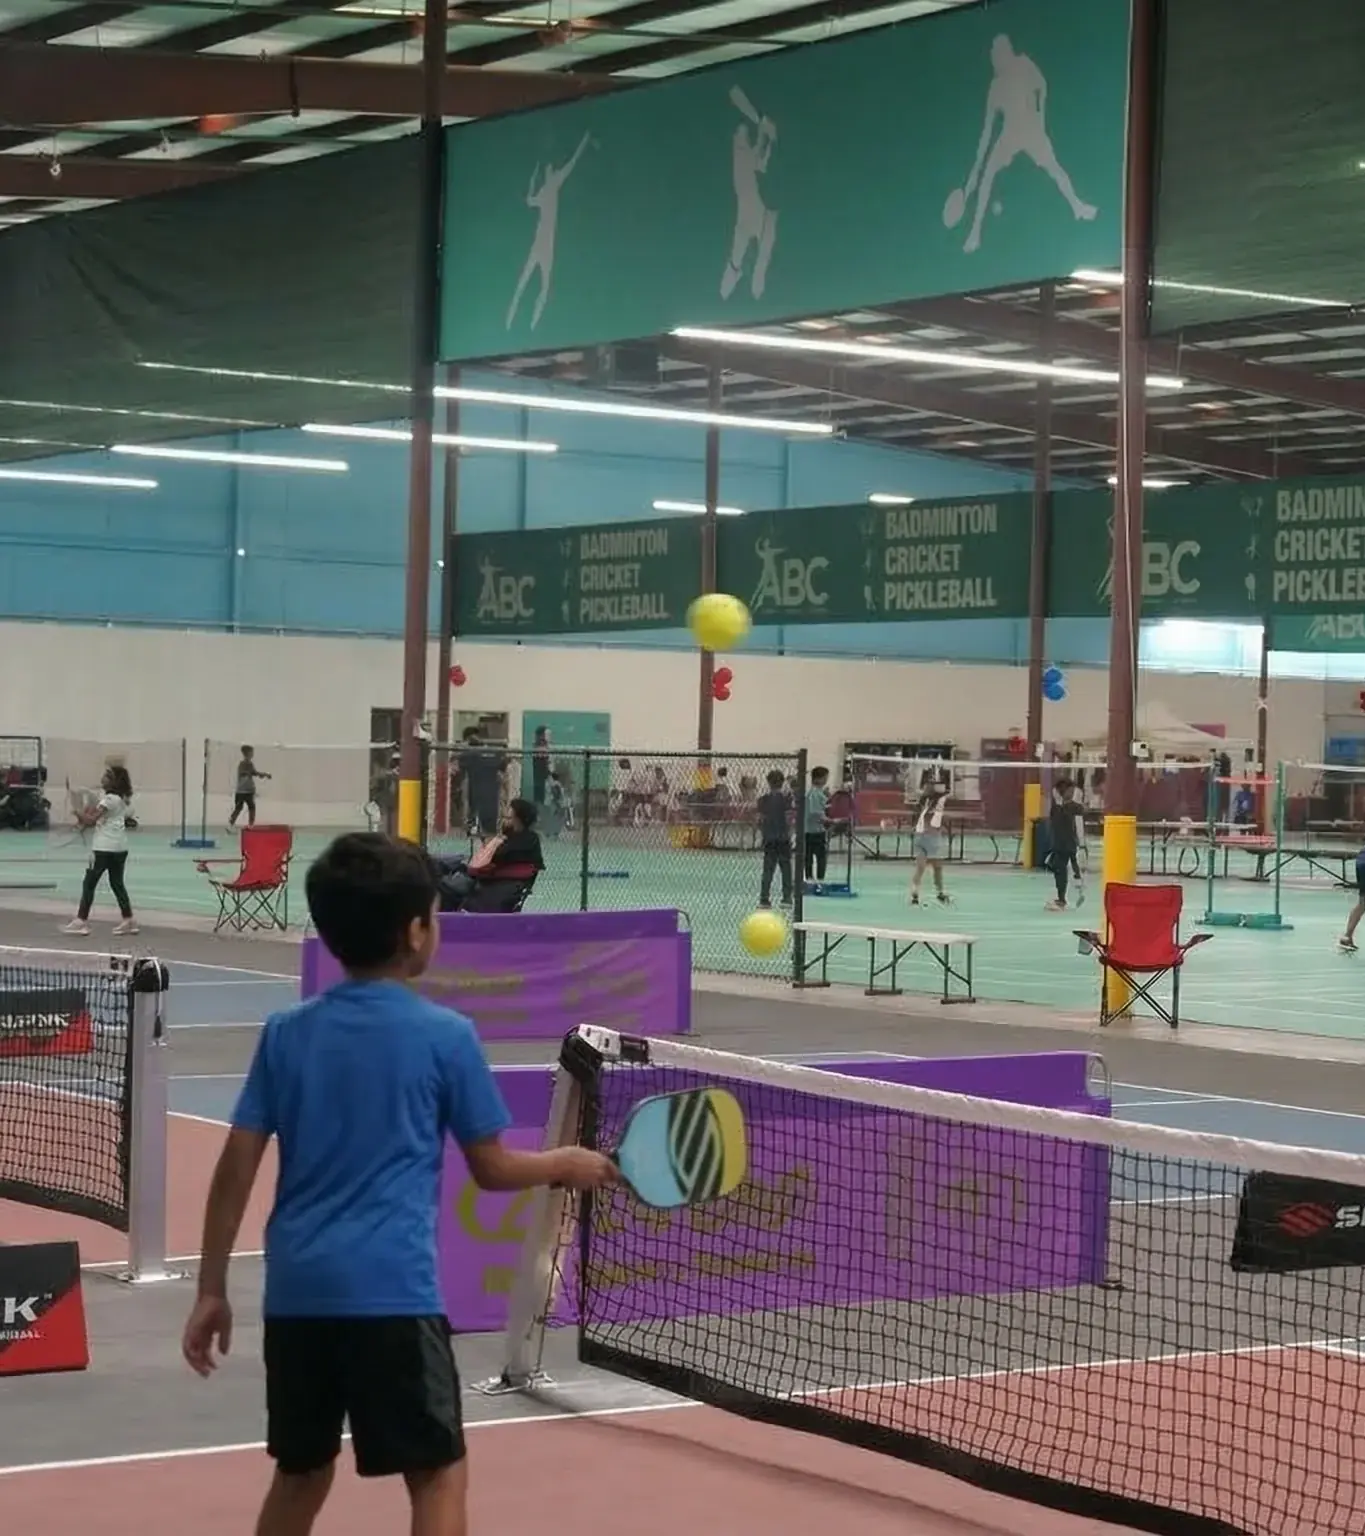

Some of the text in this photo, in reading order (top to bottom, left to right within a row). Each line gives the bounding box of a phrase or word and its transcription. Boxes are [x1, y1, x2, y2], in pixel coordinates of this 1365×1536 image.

[885, 504, 998, 540] BADMINTON
[579, 528, 669, 560] BADMINTON
[884, 544, 963, 575] CRICKET
[579, 563, 642, 592] CRICKET
[752, 555, 830, 610] ABC
[884, 577, 998, 611] PICKLEBALL
[477, 574, 536, 620] ABC
[579, 593, 671, 624] PICKLEBALL
